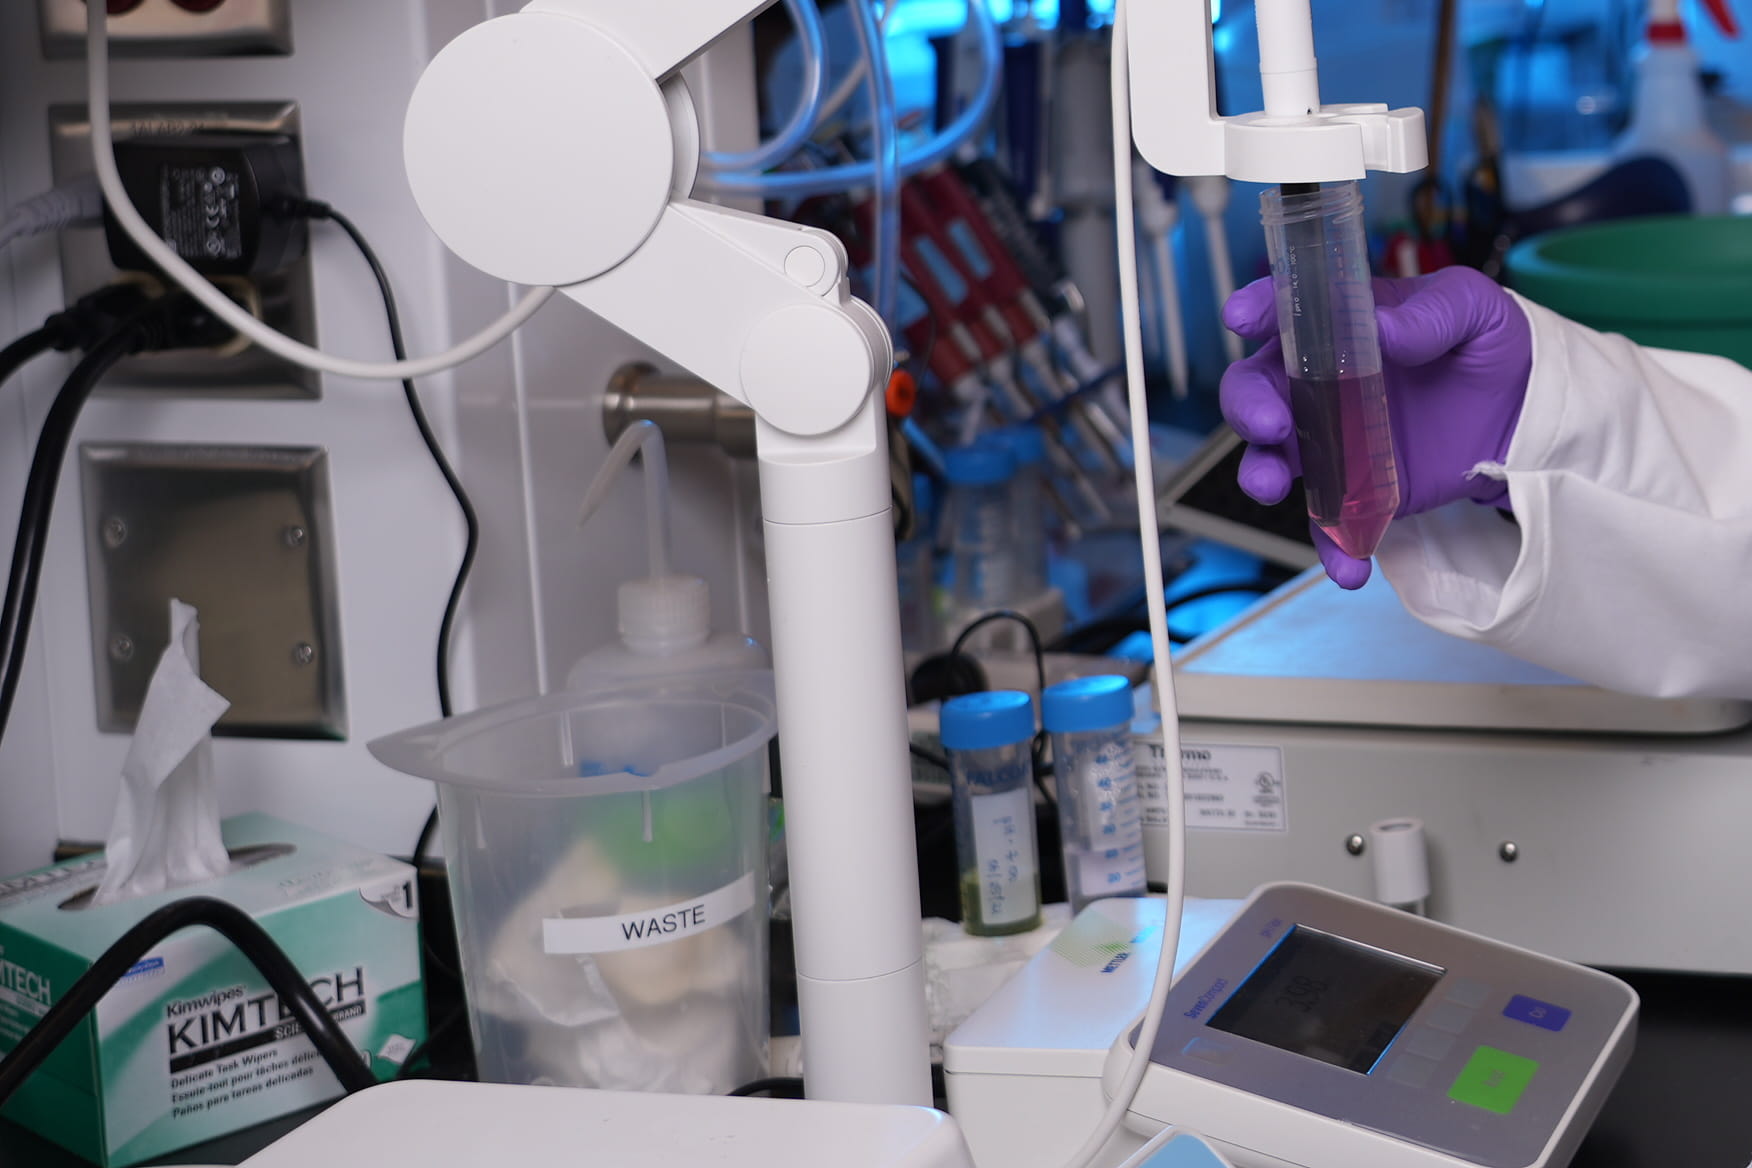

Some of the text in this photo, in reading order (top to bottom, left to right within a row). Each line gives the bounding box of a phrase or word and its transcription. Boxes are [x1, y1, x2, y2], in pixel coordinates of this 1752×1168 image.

[621, 903, 706, 941] WASTE
[167, 986, 244, 1019] Kimwipes
[171, 1069, 214, 1089] Delicate
[242, 1049, 278, 1065] Wipers
